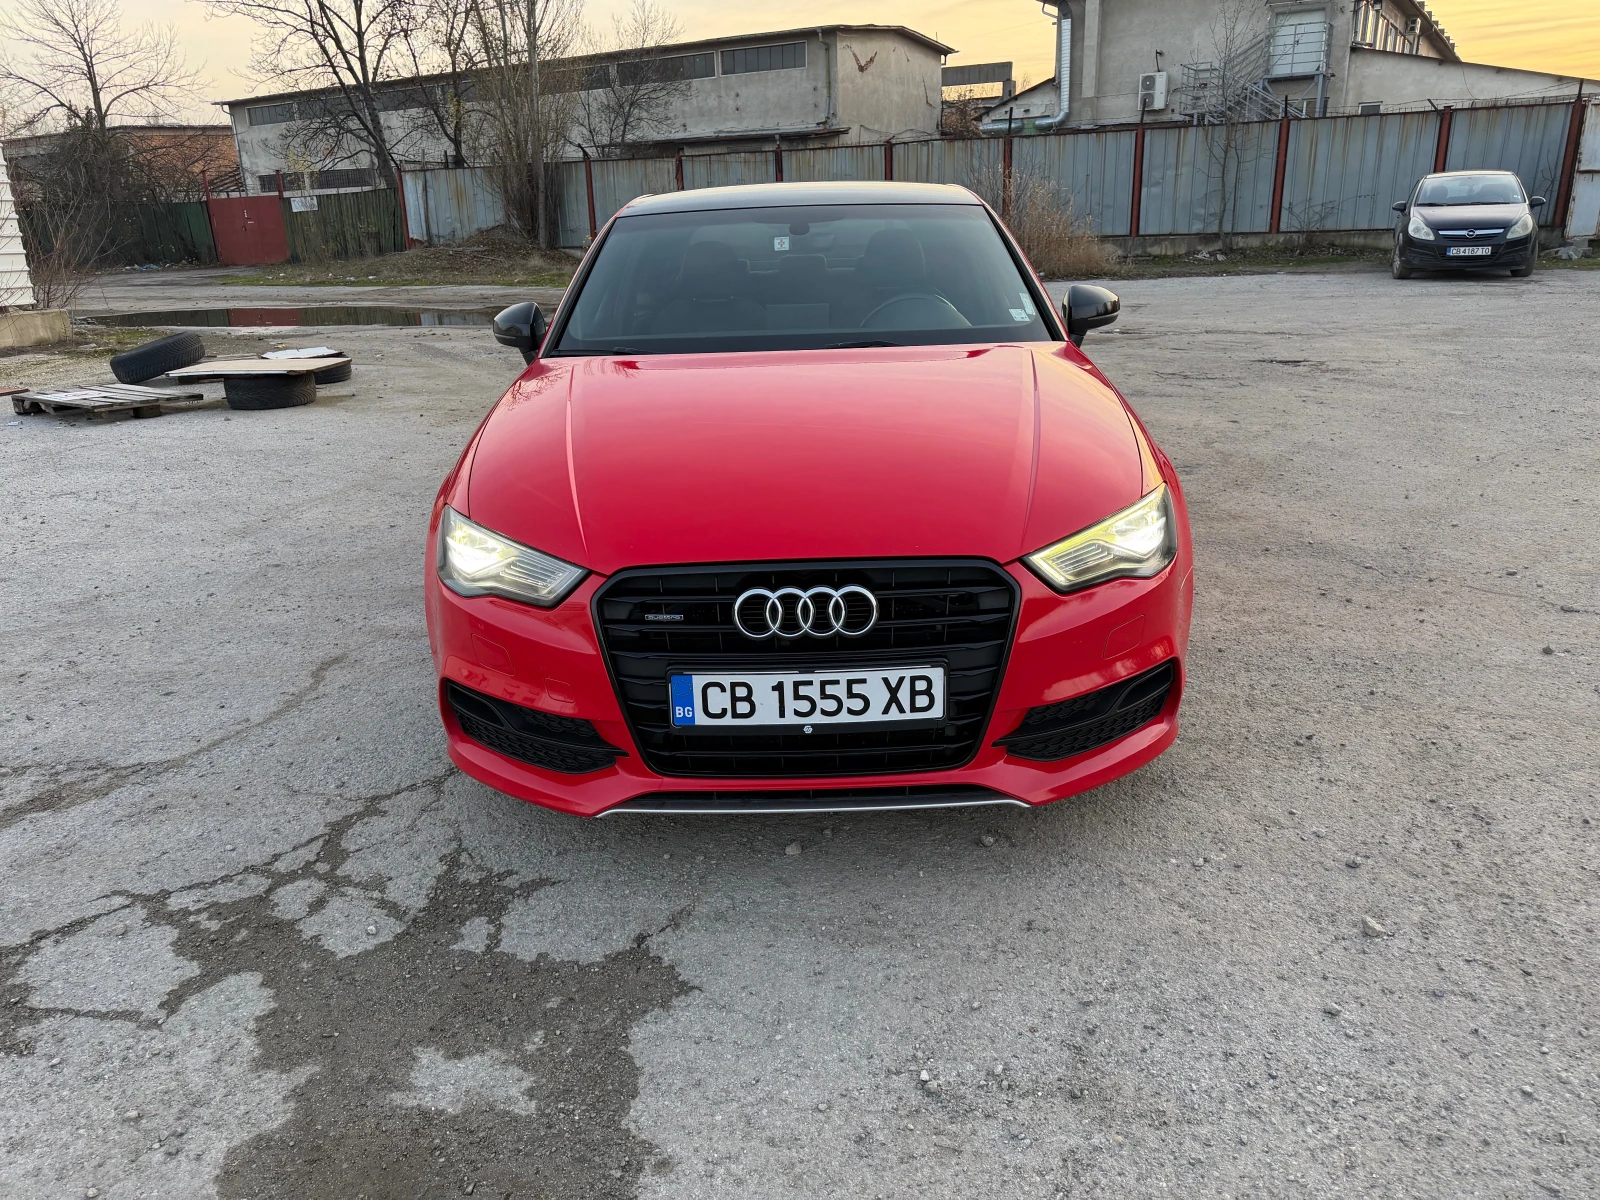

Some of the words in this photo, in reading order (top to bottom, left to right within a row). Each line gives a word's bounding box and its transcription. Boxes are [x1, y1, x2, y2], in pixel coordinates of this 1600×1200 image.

[1451, 247, 1461, 255] CB
[1462, 247, 1480, 255] 4187
[701, 681, 756, 720] CB
[771, 678, 871, 719] 1555
[881, 674, 936, 715] XB
[675, 706, 693, 718] BG
